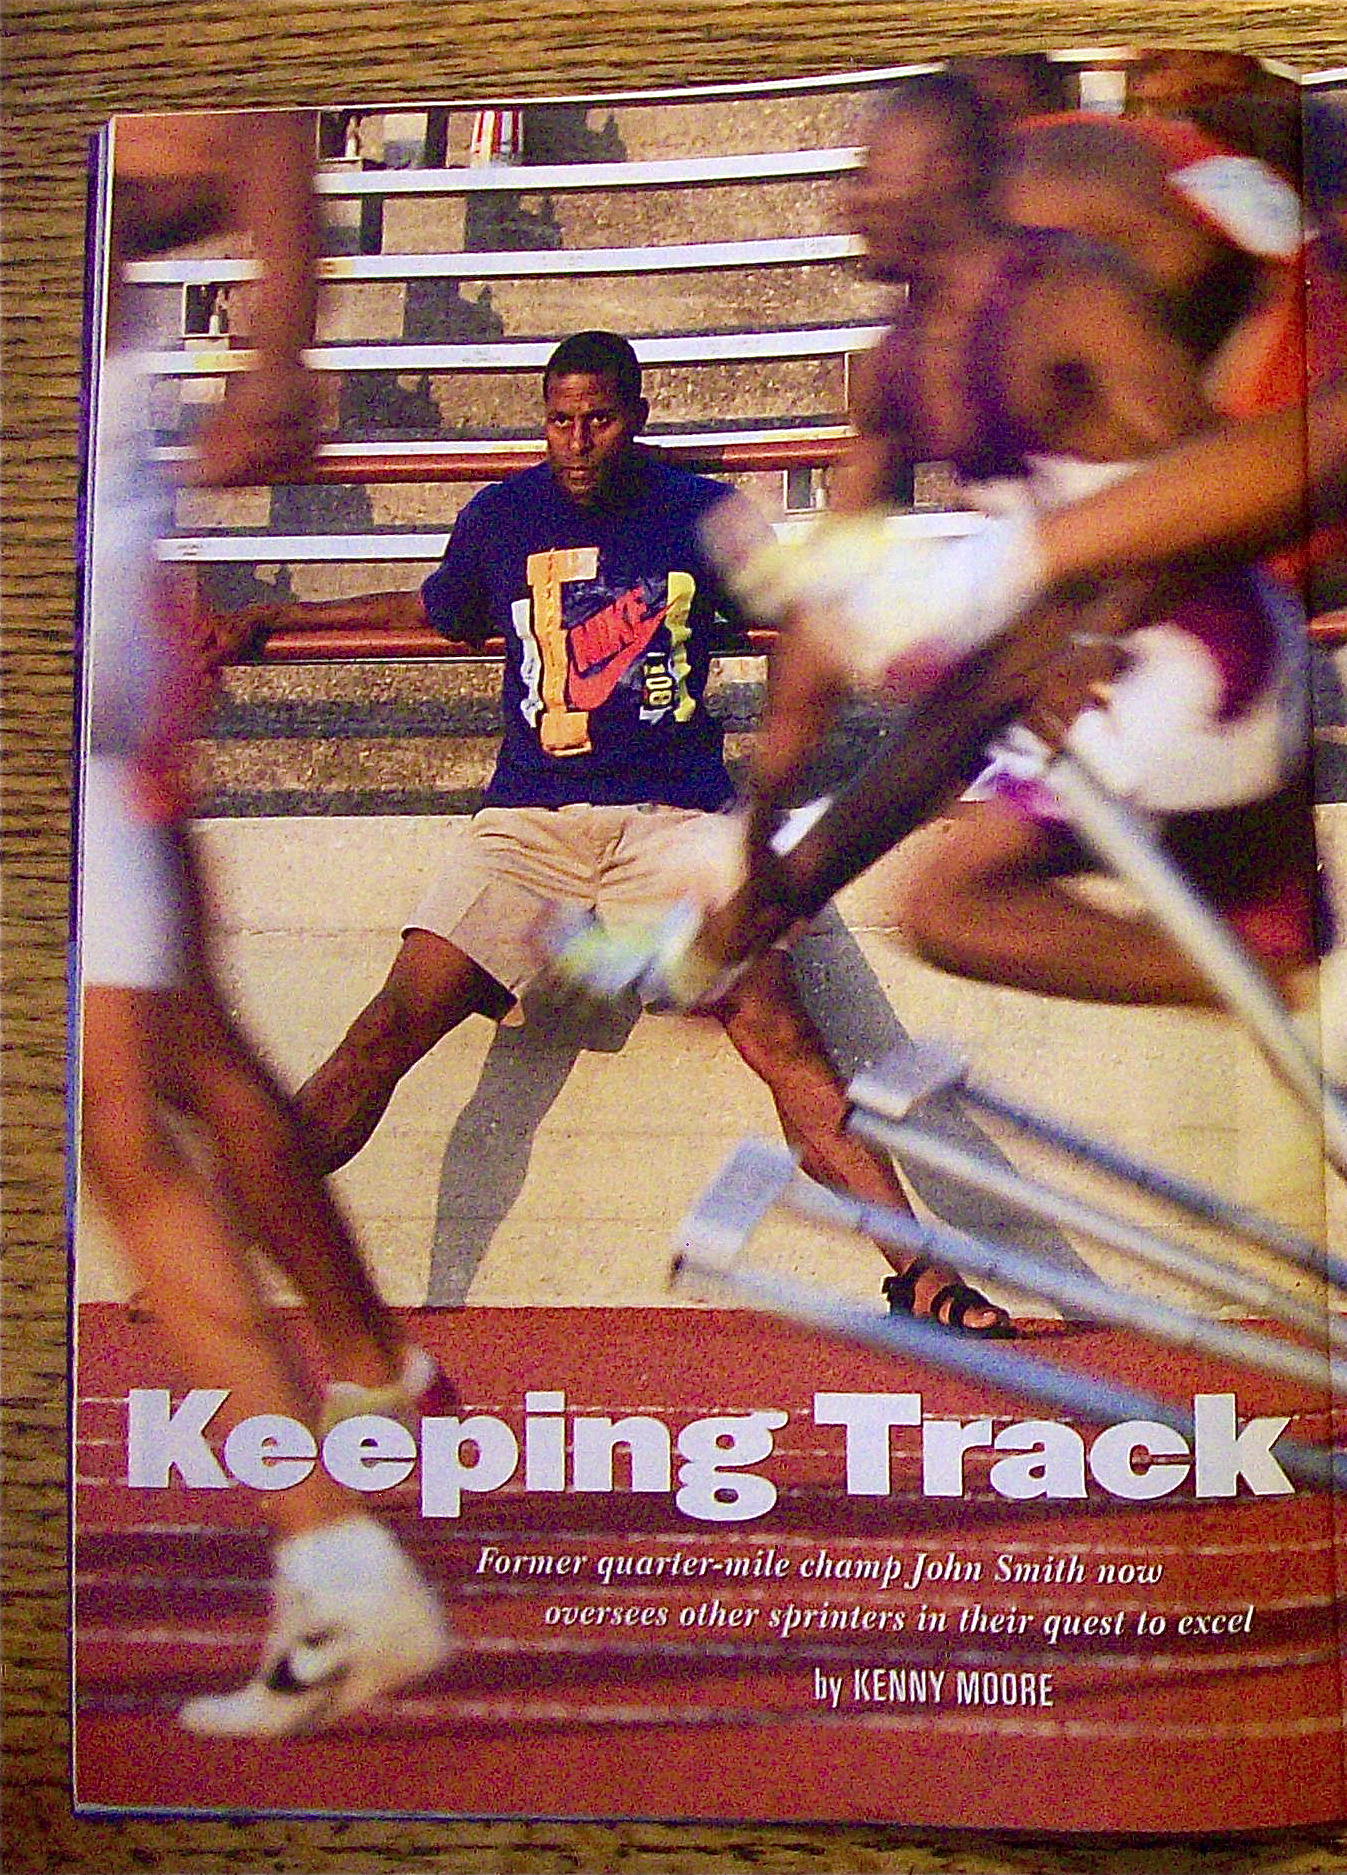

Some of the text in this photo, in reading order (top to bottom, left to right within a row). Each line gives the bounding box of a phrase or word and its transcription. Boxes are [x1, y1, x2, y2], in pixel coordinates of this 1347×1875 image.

[127, 1388, 1297, 1522] Keeping Track
[475, 1546, 1164, 1591] Former quarter-mile champ John Smith now
[543, 1599, 1256, 1646] oversees other sprinters in their quest to excel
[813, 1667, 1055, 1709] by KENNY MOORE
